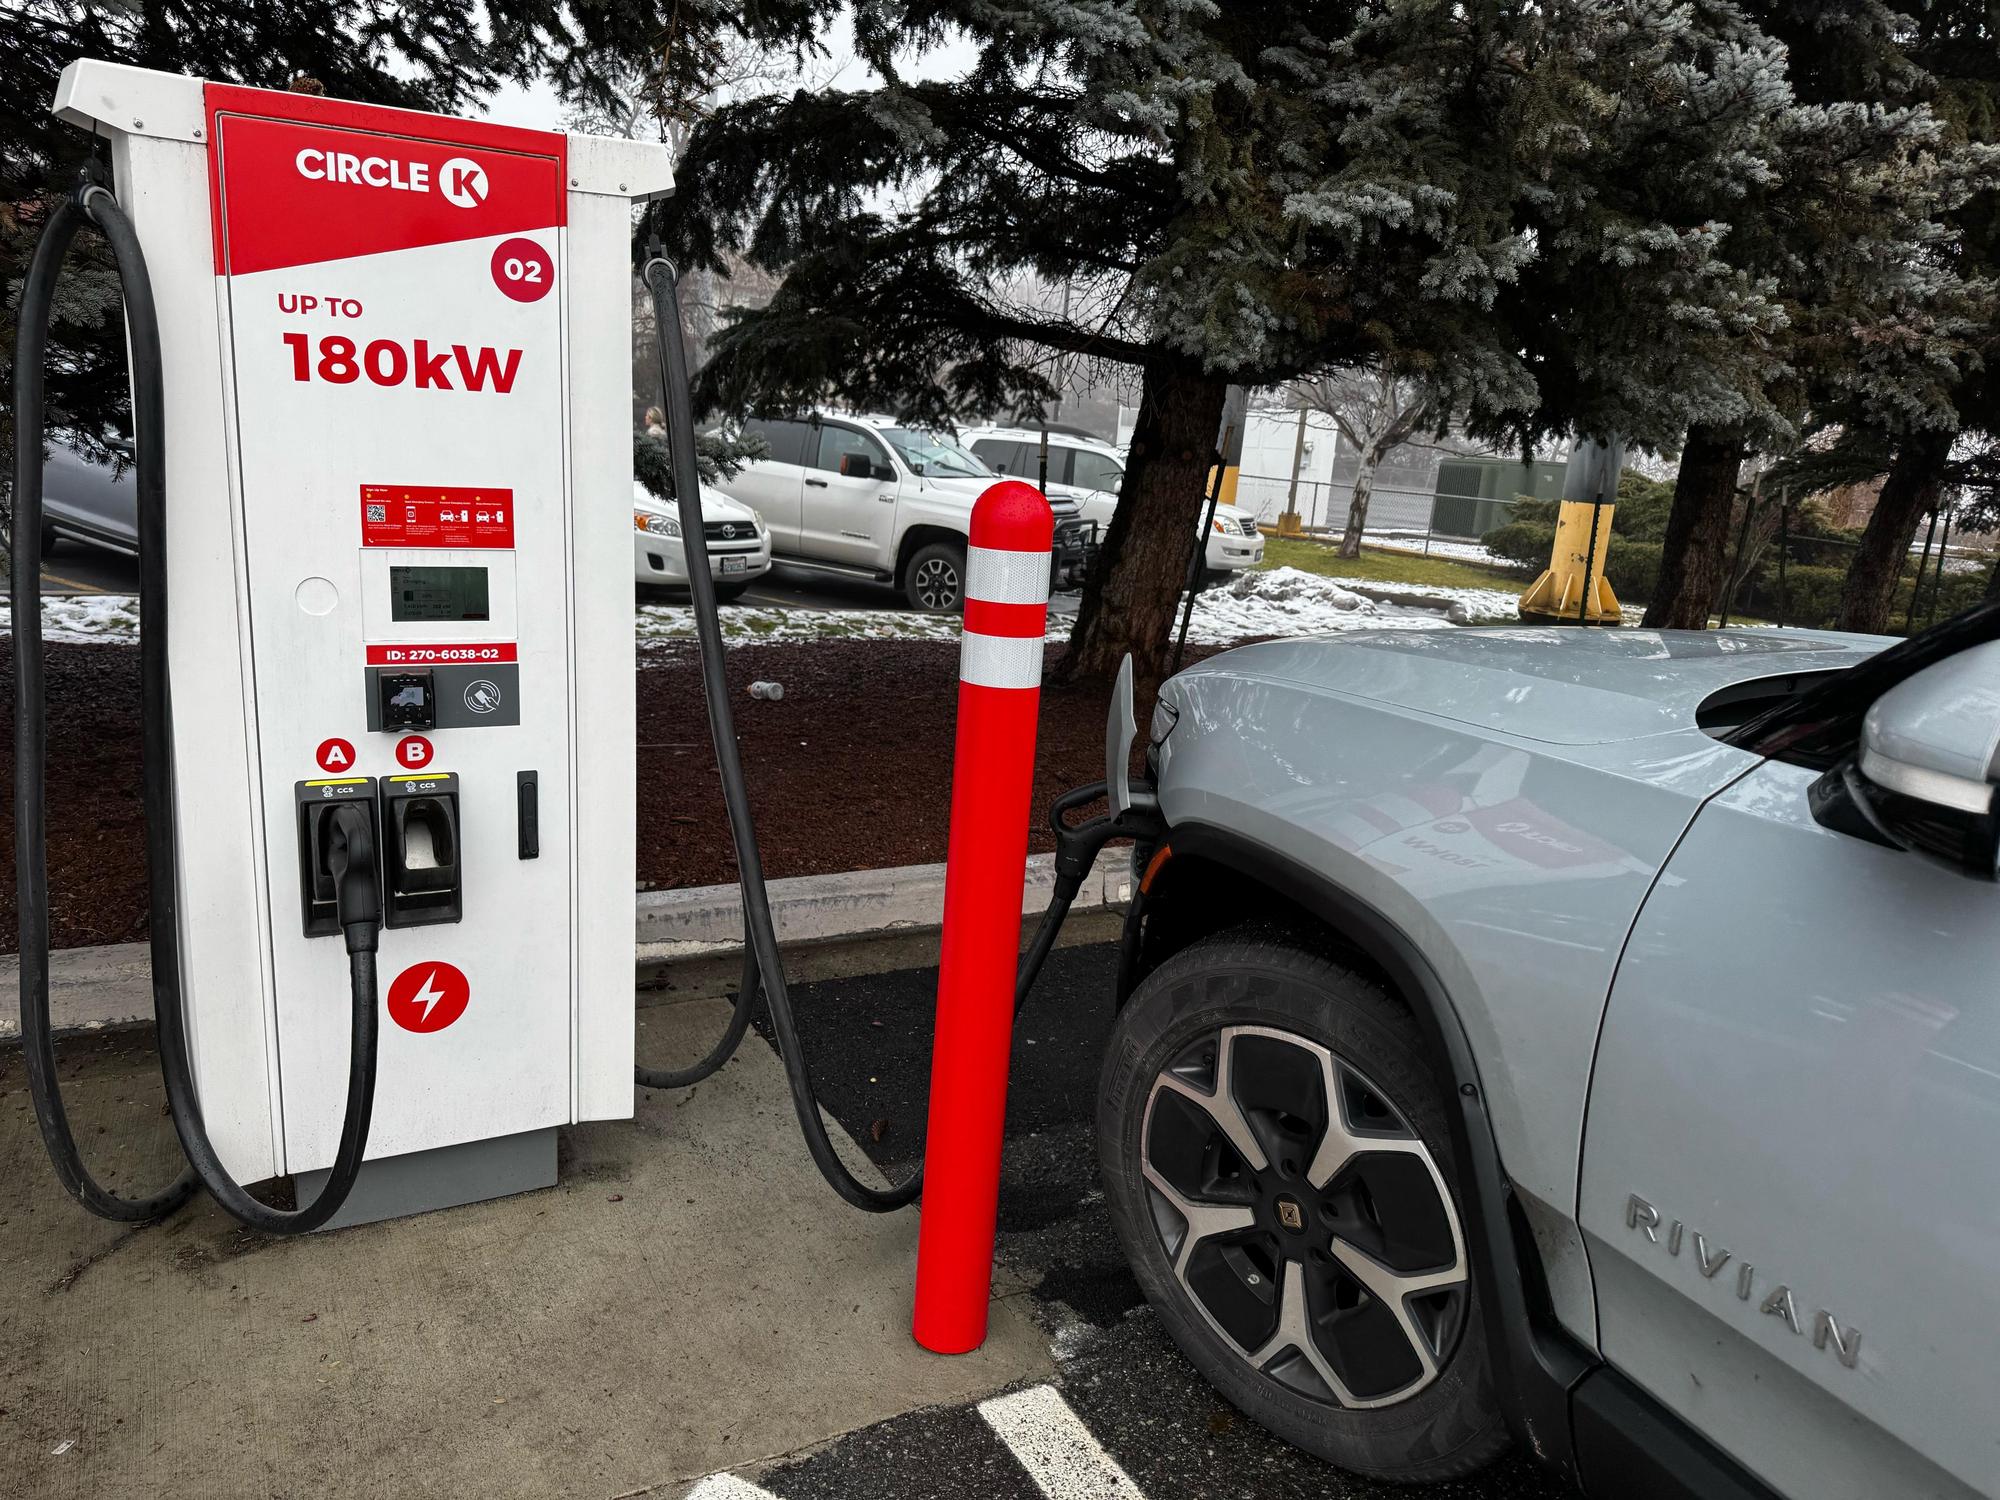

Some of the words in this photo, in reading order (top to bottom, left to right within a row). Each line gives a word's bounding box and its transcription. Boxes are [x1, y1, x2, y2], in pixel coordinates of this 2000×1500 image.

[295, 148, 430, 193] CIRCLE
[446, 163, 487, 208] K
[503, 258, 542, 283] 02
[278, 293, 318, 315] UP
[324, 297, 363, 319] TO
[282, 332, 523, 394] 180kW
[386, 650, 406, 661] ID:
[409, 648, 499, 661] 270-6038-02
[325, 745, 348, 765] A
[406, 742, 425, 762] B
[1625, 1192, 1862, 1370] RIVIAN
